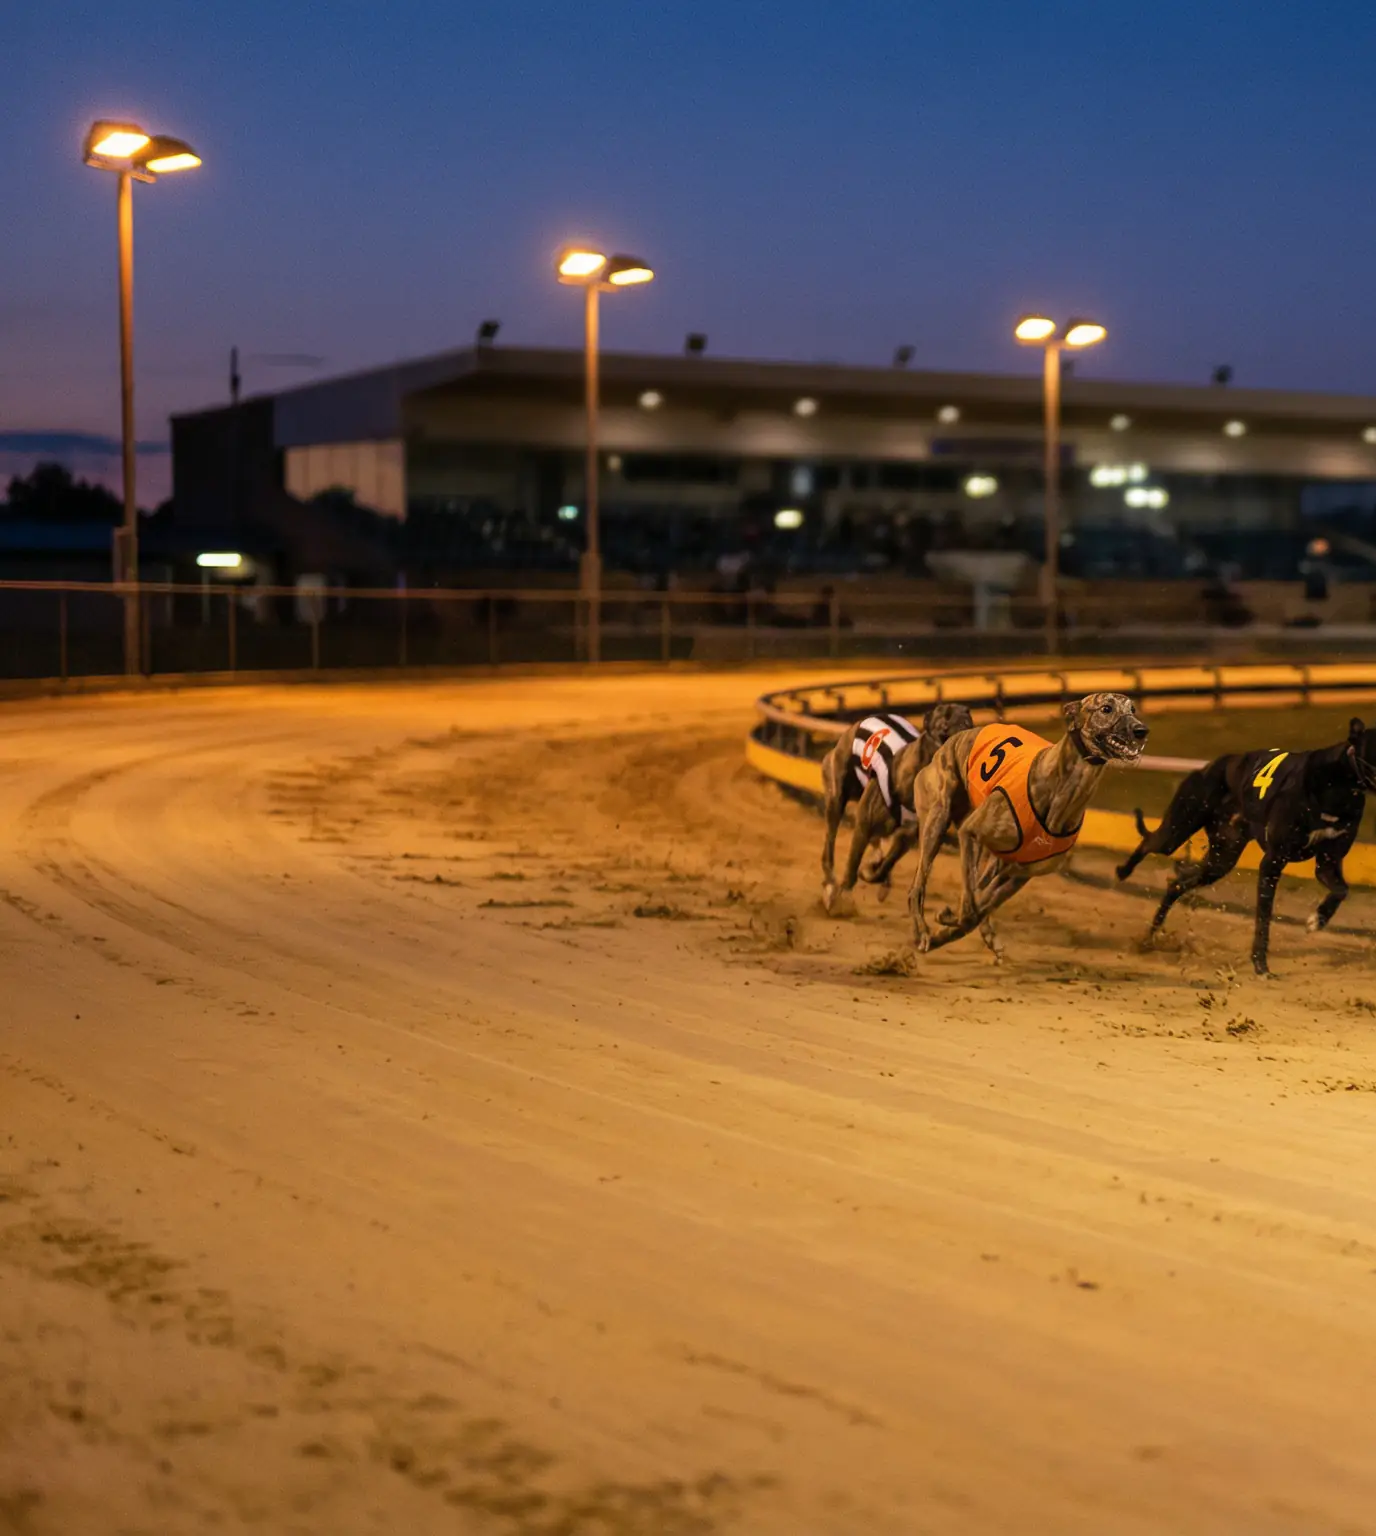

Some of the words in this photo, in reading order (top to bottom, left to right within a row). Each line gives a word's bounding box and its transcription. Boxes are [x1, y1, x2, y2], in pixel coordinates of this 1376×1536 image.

[862, 728, 891, 770] 6
[980, 736, 1023, 782] 5
[1252, 752, 1289, 800] 4
